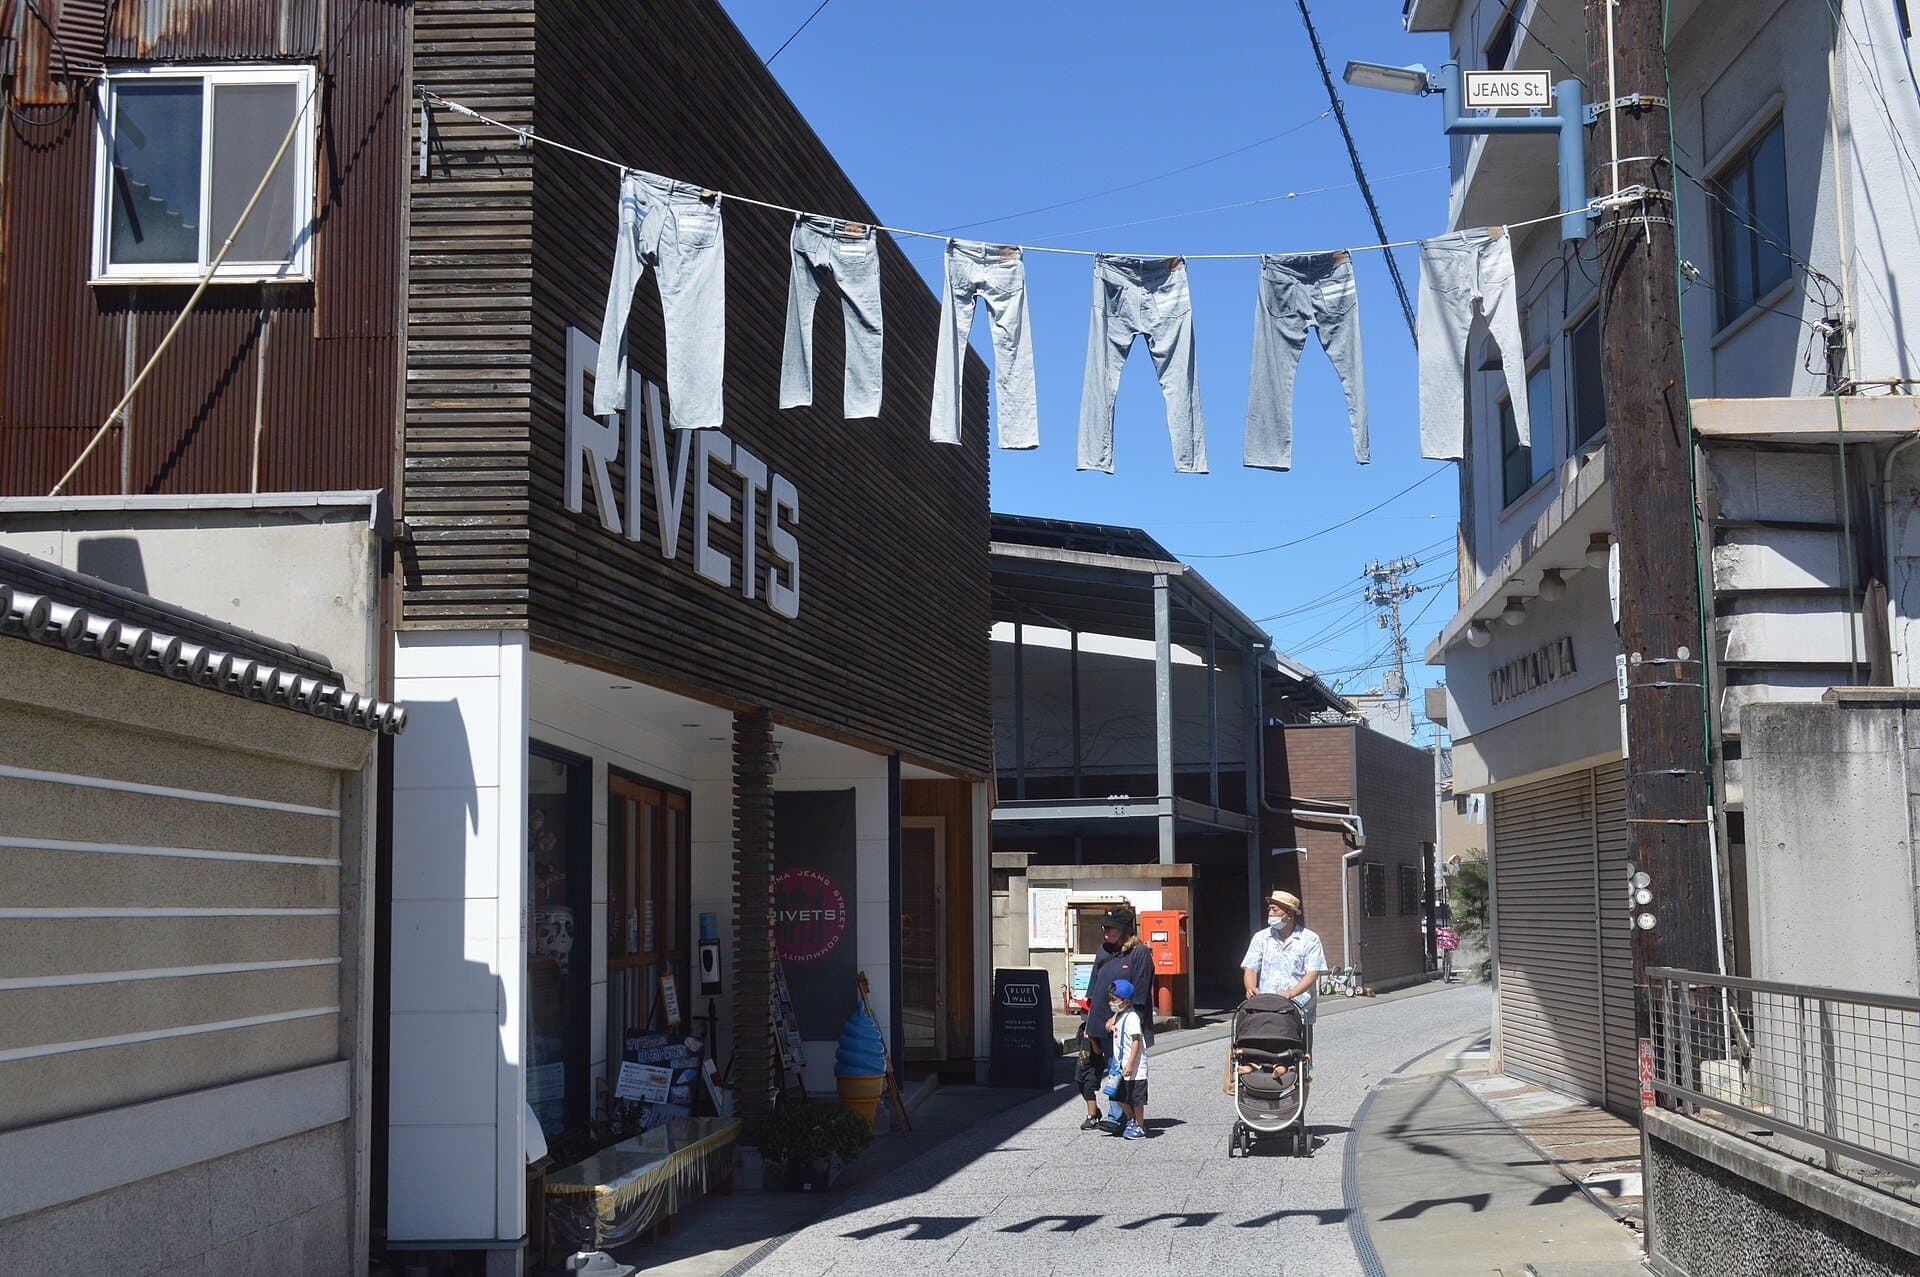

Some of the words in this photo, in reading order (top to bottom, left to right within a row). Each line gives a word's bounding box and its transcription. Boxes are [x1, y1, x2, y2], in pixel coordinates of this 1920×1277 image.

[1472, 82, 1519, 97] JEANS
[1524, 82, 1543, 97] St.
[564, 326, 800, 619] RIVETS
[797, 870, 831, 886] JEANS
[833, 889, 846, 929] STREET
[782, 935, 839, 960] COMMUNITY
[1009, 986, 1031, 994] BLUE
[1011, 995, 1032, 1003] WALL
